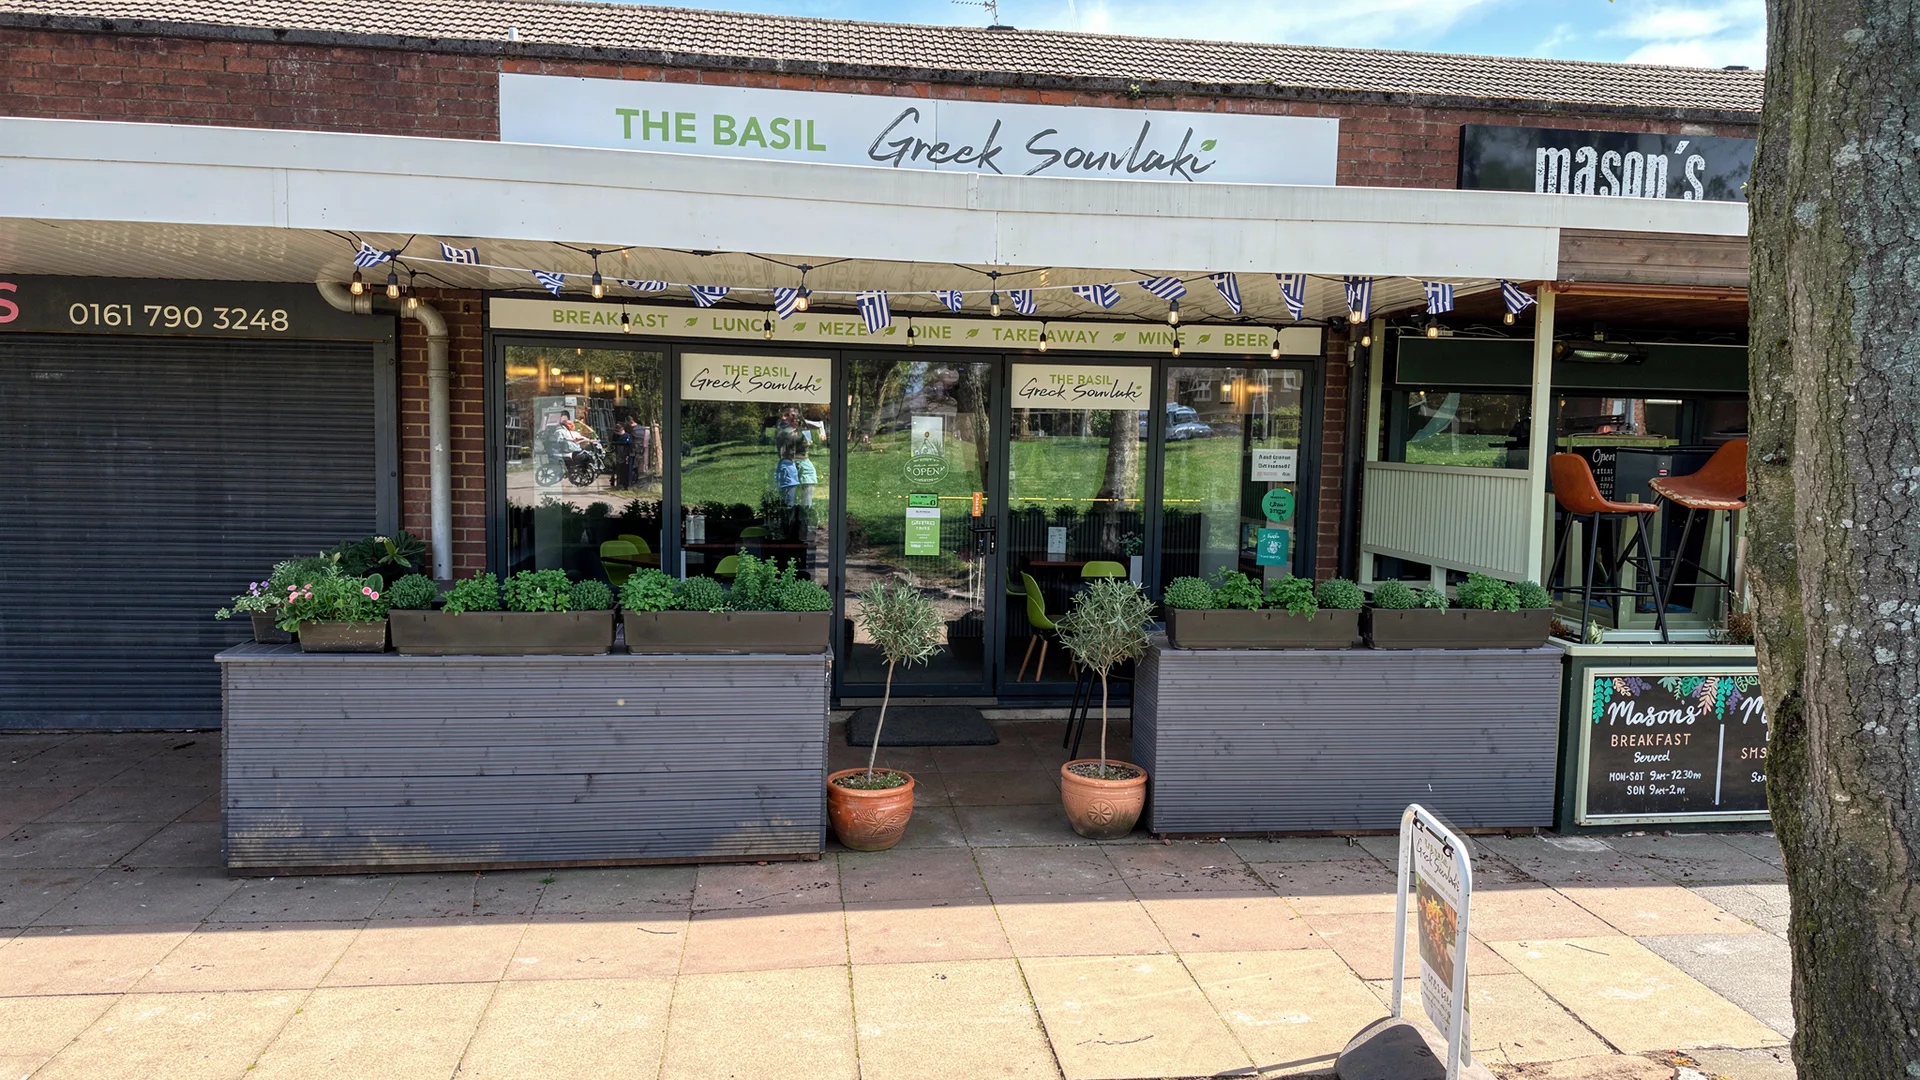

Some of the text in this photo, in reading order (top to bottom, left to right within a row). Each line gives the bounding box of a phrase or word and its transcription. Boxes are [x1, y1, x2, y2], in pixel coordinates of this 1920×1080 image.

[615, 106, 1217, 182] THE BASIL Greek Souvlaki
[68, 302, 290, 332] 0161 790 3248
[552, 309, 669, 329] BREAKAST
[818, 321, 868, 337] MEZE
[1138, 331, 1186, 346] WINE
[1223, 332, 1269, 347] BEER
[722, 364, 791, 378] THE BASIL
[1049, 373, 1113, 386] THE BASIL
[689, 367, 822, 396] Greek Souvlaki
[1018, 377, 1143, 403] Greek Souvlaki
[1592, 448, 1616, 467] Open
[912, 467, 941, 476] OPEN
[1610, 732, 1692, 748] BREAKFAST
[1633, 749, 1671, 764] Served
